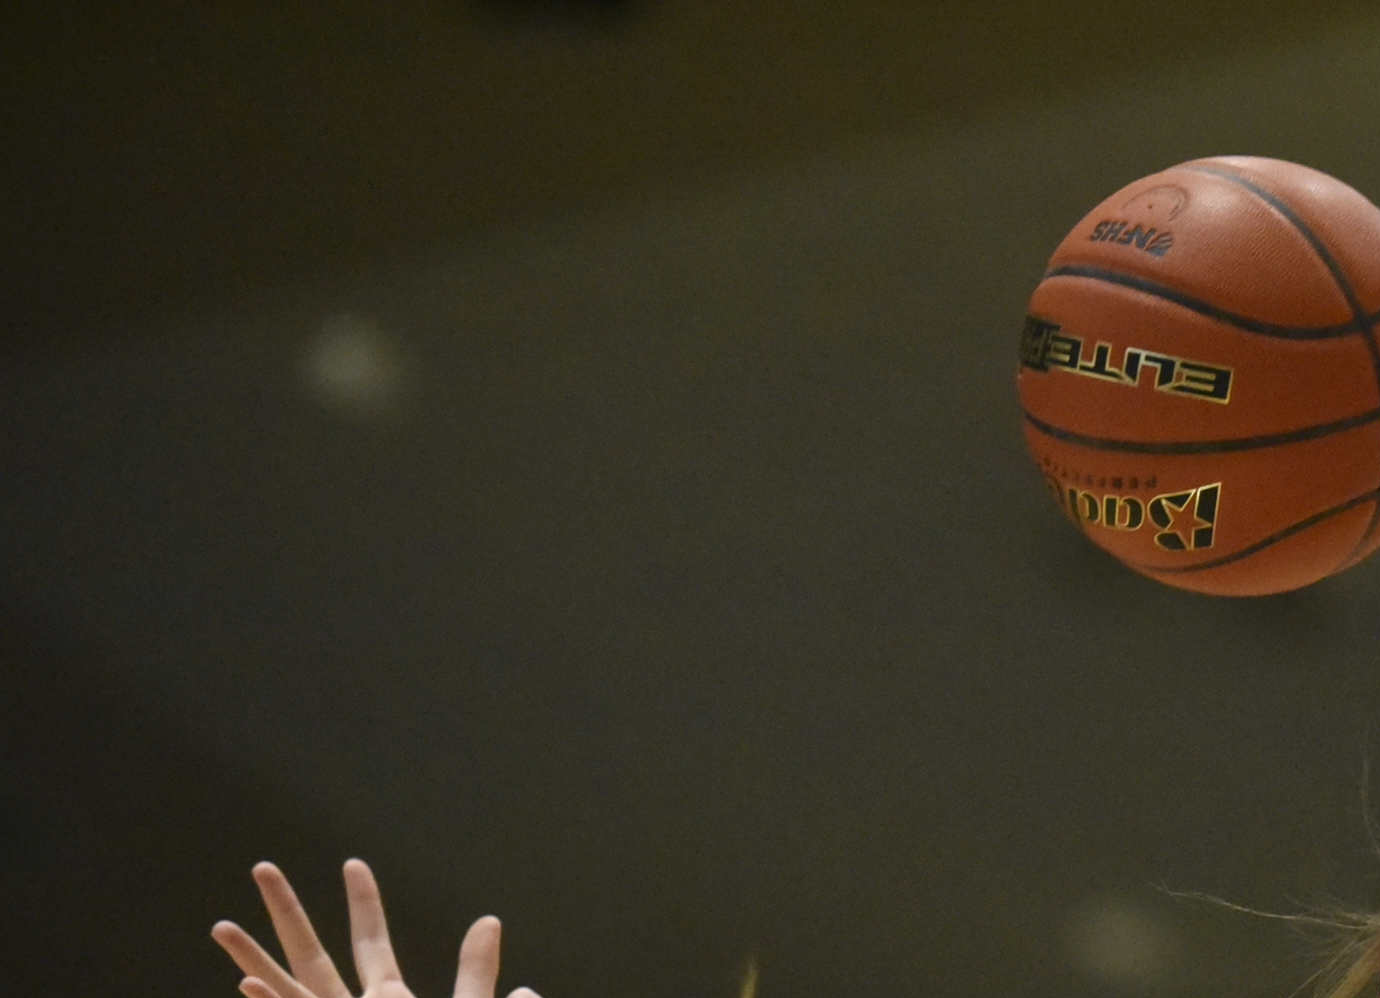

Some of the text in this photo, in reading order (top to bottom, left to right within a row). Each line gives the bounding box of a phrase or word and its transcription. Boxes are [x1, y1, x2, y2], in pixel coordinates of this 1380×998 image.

[1090, 220, 1148, 253] NFHS
[1048, 335, 1235, 404] ELITE
[1045, 480, 1222, 552] Bad
